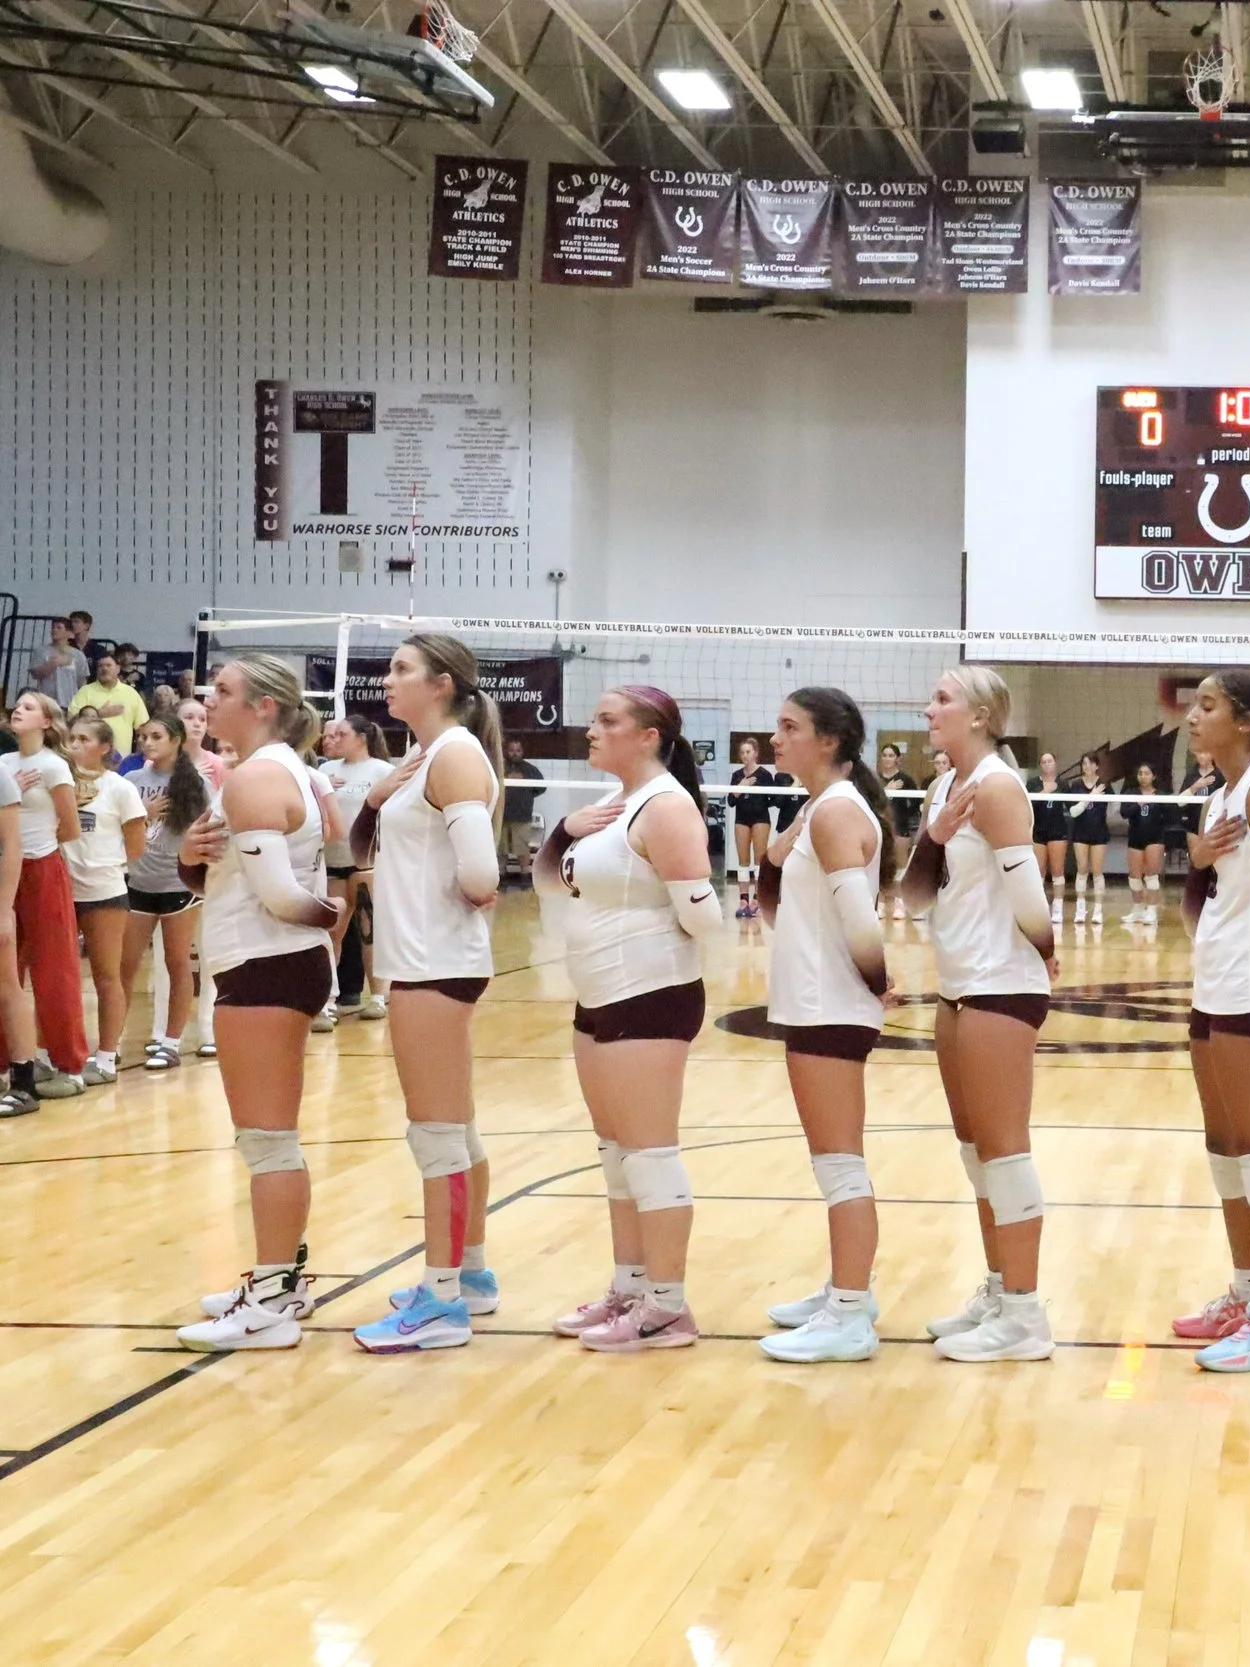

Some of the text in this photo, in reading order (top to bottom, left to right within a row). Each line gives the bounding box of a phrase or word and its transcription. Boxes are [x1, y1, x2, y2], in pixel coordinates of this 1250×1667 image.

[477, 167, 517, 190] OWEN
[589, 172, 630, 196] OWEN
[650, 170, 732, 186] C.D. OWEN
[747, 179, 829, 193] C.D. OWEN
[845, 183, 928, 196] C.D. OWEN
[942, 180, 1024, 193] C.D. OWEN
[1053, 186, 1136, 198] C.D. OWEN
[443, 189, 517, 202] HIGH SCHOOL
[662, 188, 720, 198] HIGH SCHOOL
[556, 196, 631, 208] HIGH SCHOOL
[859, 200, 880, 208] HIGH
[955, 197, 1012, 205] HIGH SCHOOL
[452, 210, 505, 223] ATHLETICS
[566, 217, 619, 229] ATHLETICS
[991, 222, 1022, 231] Country
[457, 229, 497, 238] 2010-2011
[895, 226, 926, 234] Country
[977, 231, 1021, 240] Champions
[443, 235, 512, 247] STATE CHAMPION
[883, 234, 924, 243] Champion
[447, 242, 473, 251] TRACK
[677, 245, 698, 254] 2022
[454, 253, 499, 263] HIGH JUMP
[660, 255, 713, 265] Men's Soccer
[776, 253, 796, 261] 2022
[448, 260, 504, 270] EMILY KIMBLE
[646, 265, 726, 277] 2A State Champions
[745, 264, 769, 272] Men's
[794, 265, 828, 275] Country
[1141, 411, 1163, 446] 0
[263, 388, 279, 531] THANK YOU
[1211, 447, 1250, 463] period
[1100, 471, 1174, 489] fouls-player
[293, 523, 519, 538] WARHORSE SIGN CONTRIBUTORS
[1141, 524, 1172, 539] team
[463, 619, 490, 628] OWEN
[494, 621, 553, 630] VOLLEYBALL
[563, 622, 591, 630] OWEN
[595, 623, 653, 633] VOLLEYBALL
[664, 625, 692, 633] OWEN
[696, 626, 754, 635] VOLLEYBALL
[765, 627, 792, 636] OWEN
[797, 628, 854, 637] VOLLEYBALL
[866, 629, 894, 637] OWEN
[898, 630, 955, 639] VOLLEYBALL
[999, 632, 1057, 641] VOLLEYBALL
[1069, 634, 1096, 642] OWEN
[1100, 634, 1159, 643] VOLLEYBALL
[1170, 635, 1198, 643] OWEN
[498, 677, 525, 688] MENS
